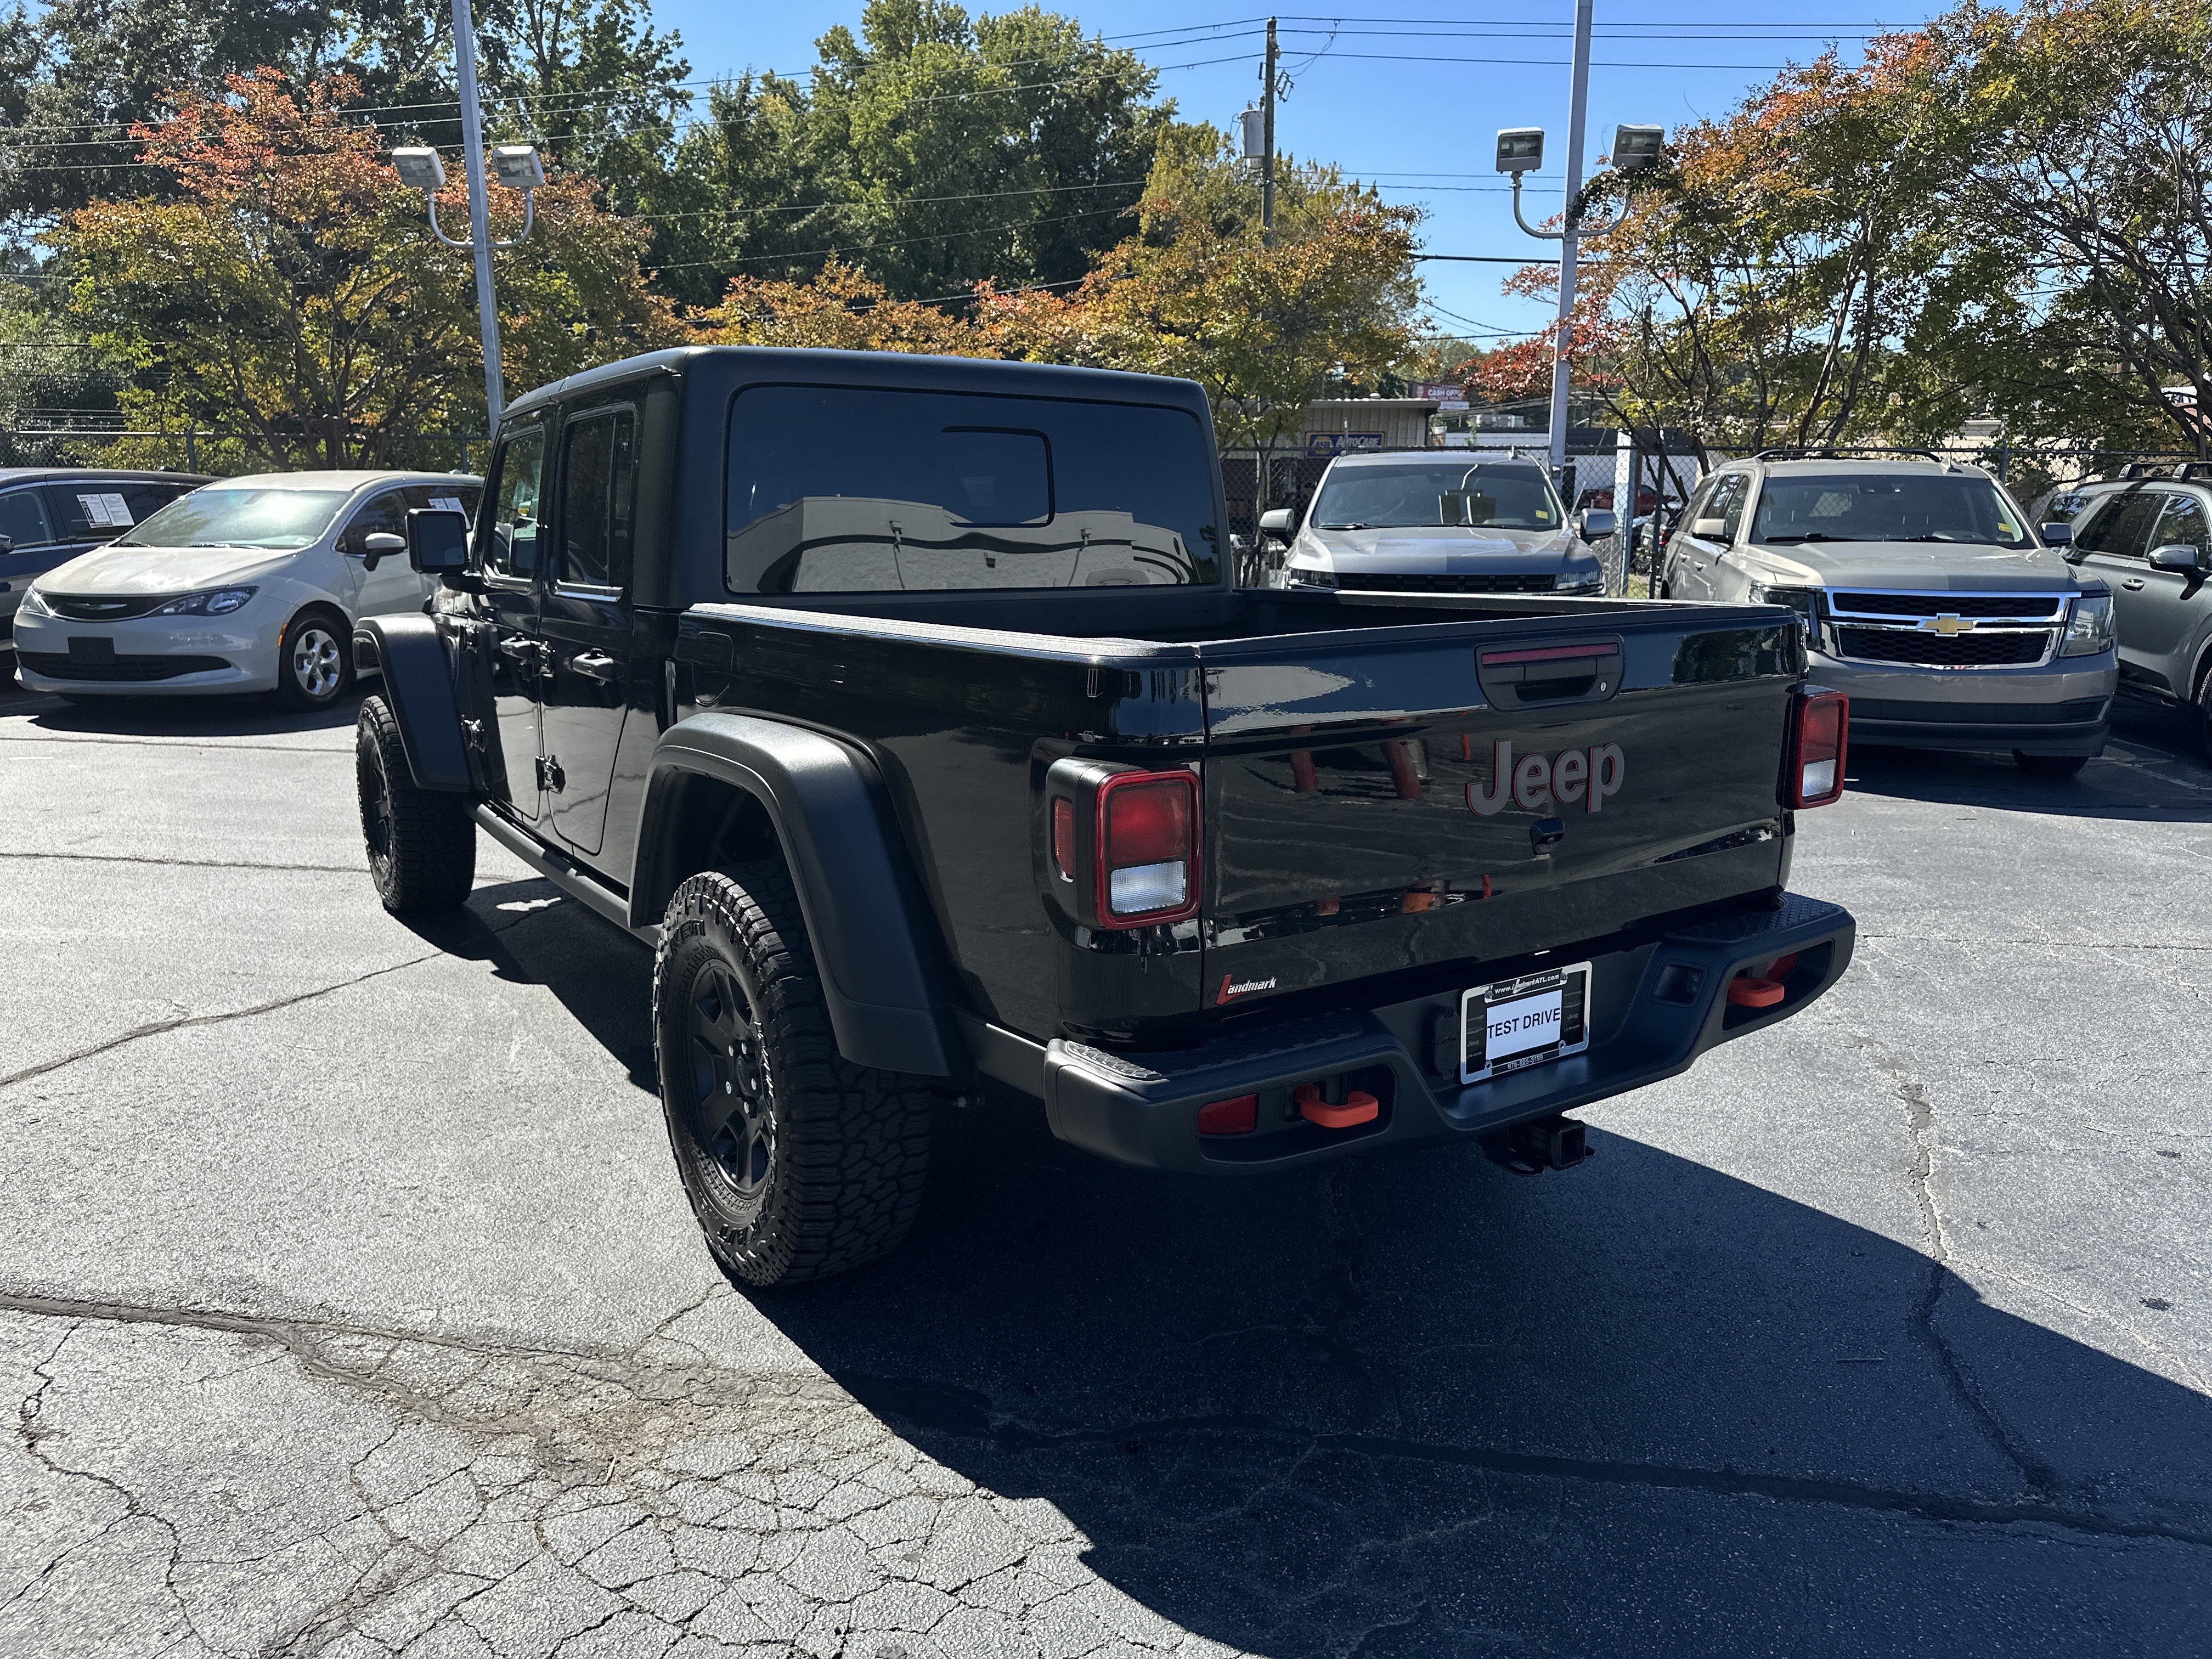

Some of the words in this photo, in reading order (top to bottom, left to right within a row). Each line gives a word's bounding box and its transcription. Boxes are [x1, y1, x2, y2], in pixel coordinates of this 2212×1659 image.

[1465, 739, 1624, 816] Jeep
[1216, 974, 1277, 1006] Landmark
[1487, 1018, 1520, 1039] TEST
[1523, 1007, 1561, 1029] DRIVE
